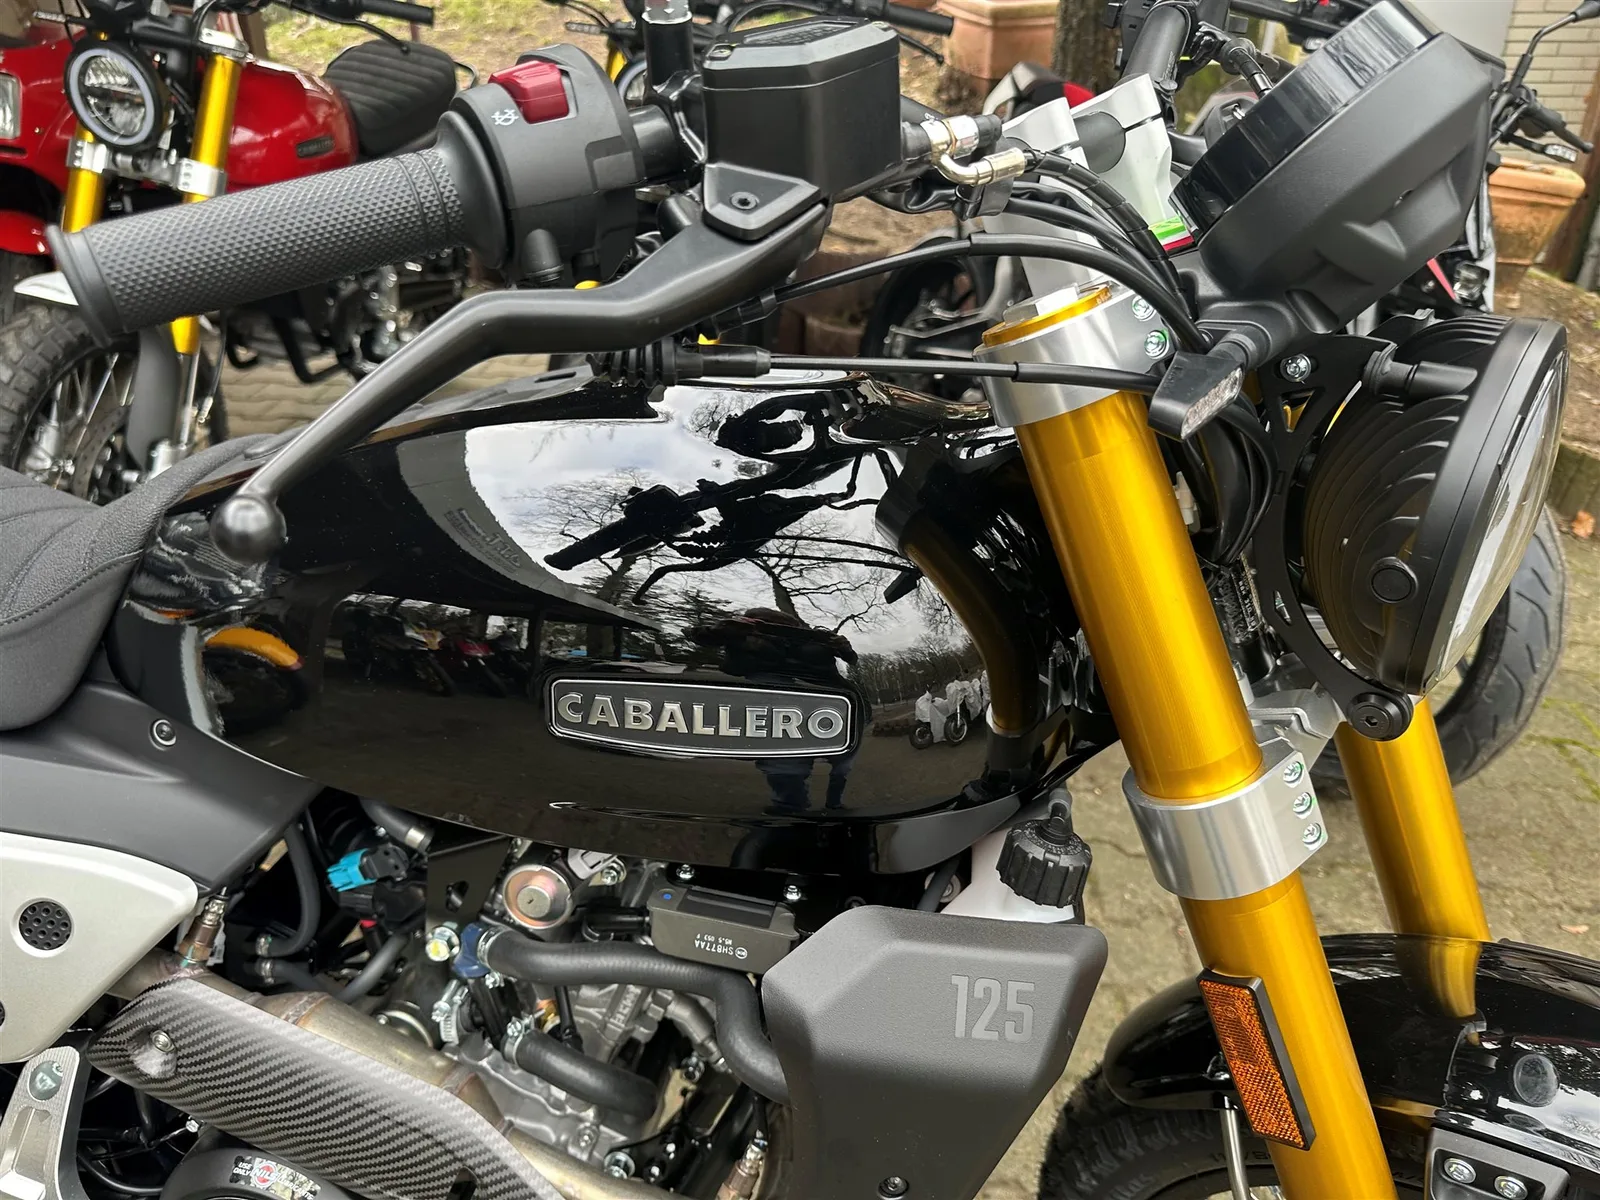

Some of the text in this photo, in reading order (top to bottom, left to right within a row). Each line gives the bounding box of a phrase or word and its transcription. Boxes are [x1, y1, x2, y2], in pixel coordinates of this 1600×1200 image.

[557, 692, 845, 739] CABALLERO
[694, 939, 734, 956] SH877AA
[951, 974, 1035, 1042] 125
[232, 1167, 251, 1176] ONLY
[238, 1161, 253, 1170] USE
[252, 1167, 279, 1181] NILS
